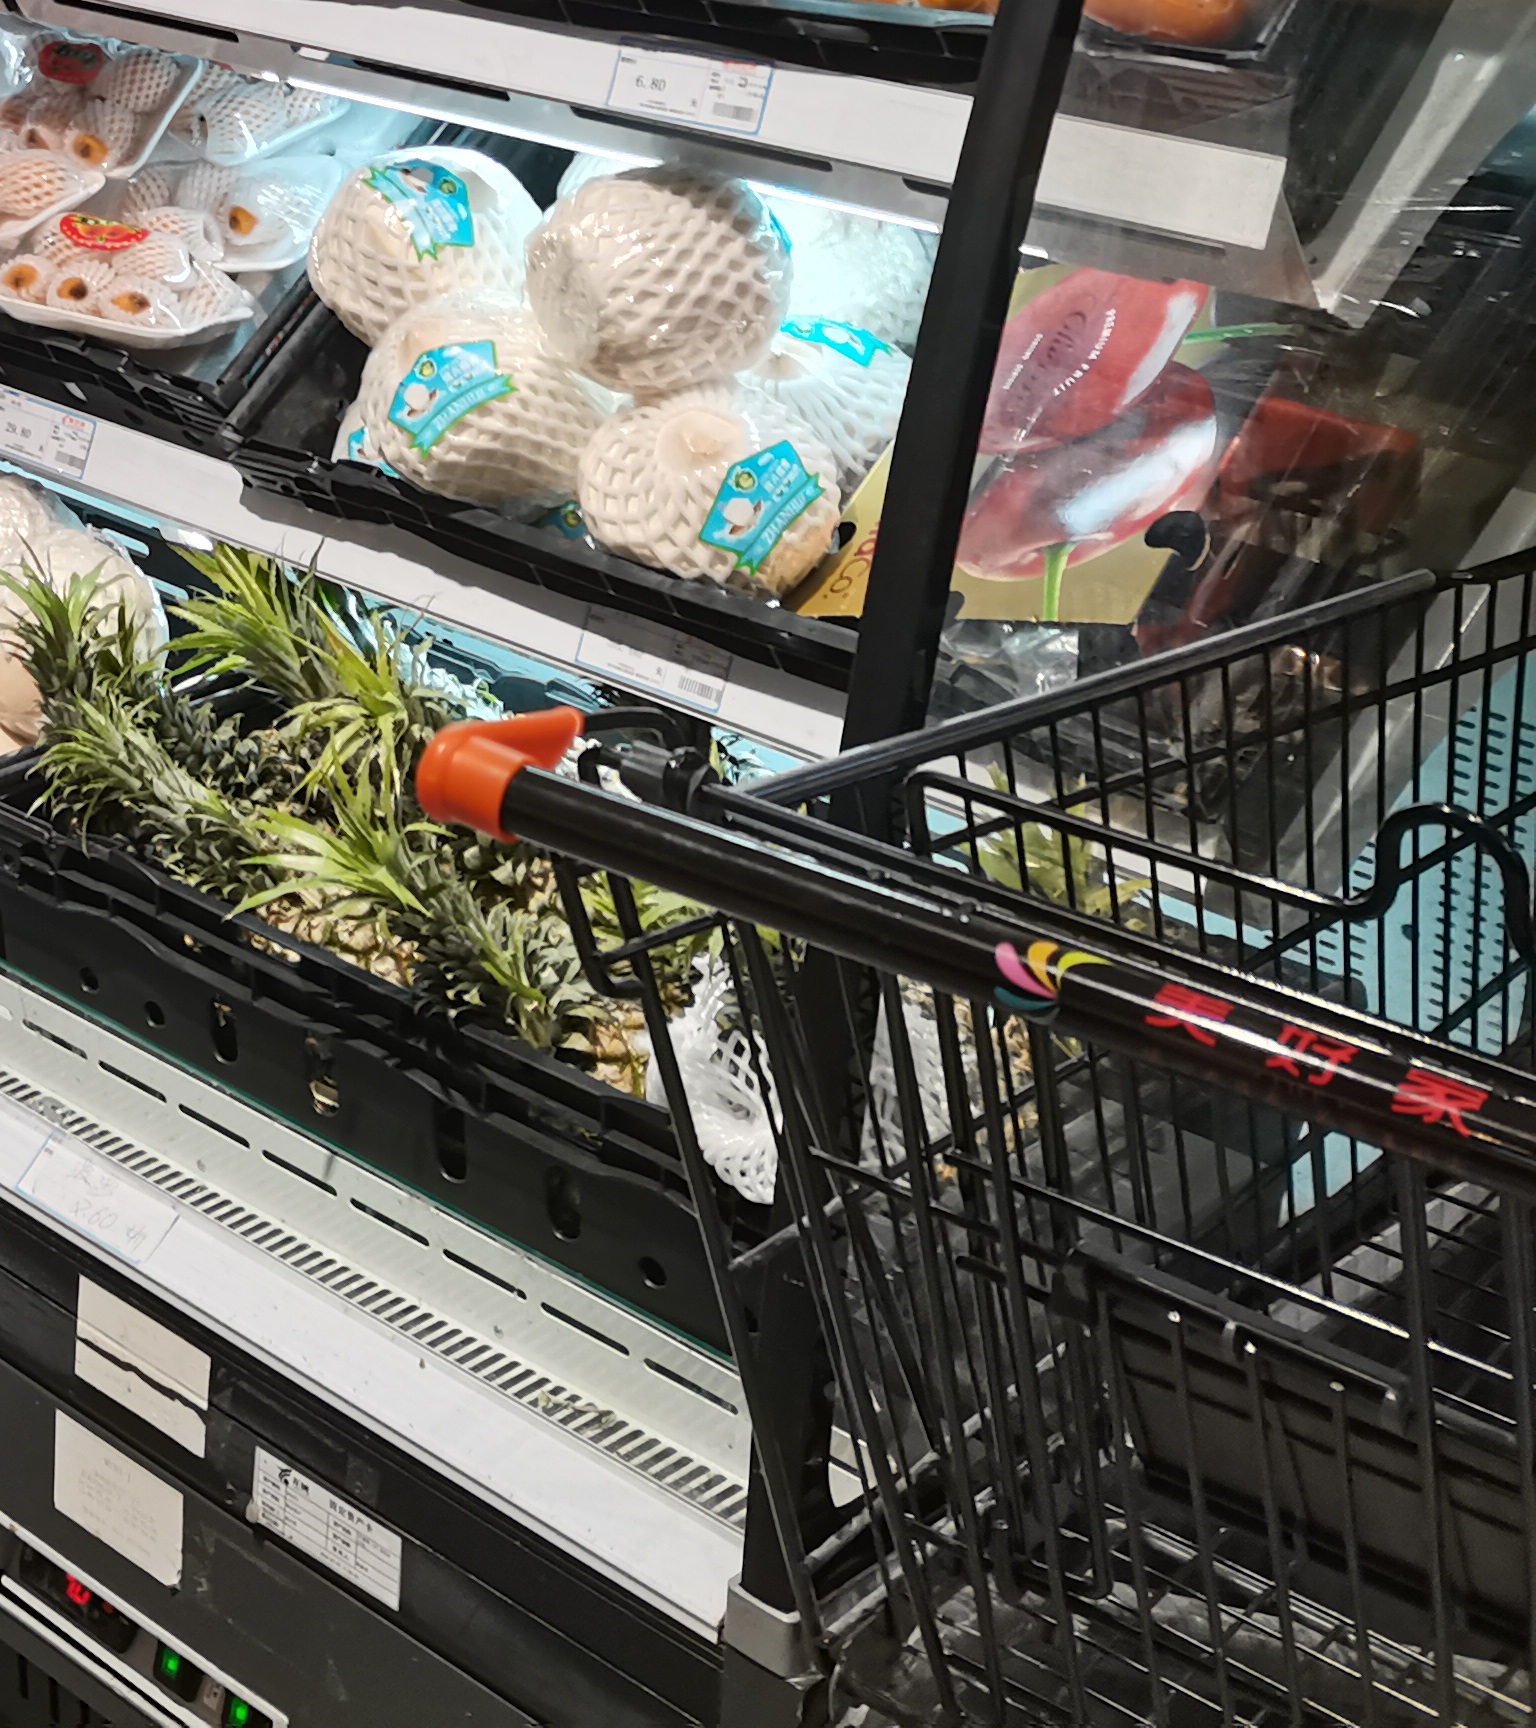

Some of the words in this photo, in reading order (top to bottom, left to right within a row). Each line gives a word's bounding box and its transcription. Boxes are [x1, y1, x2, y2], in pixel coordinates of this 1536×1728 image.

[1052, 363, 1091, 397] FRUIT
[1144, 983, 1488, 1137] 美好家
